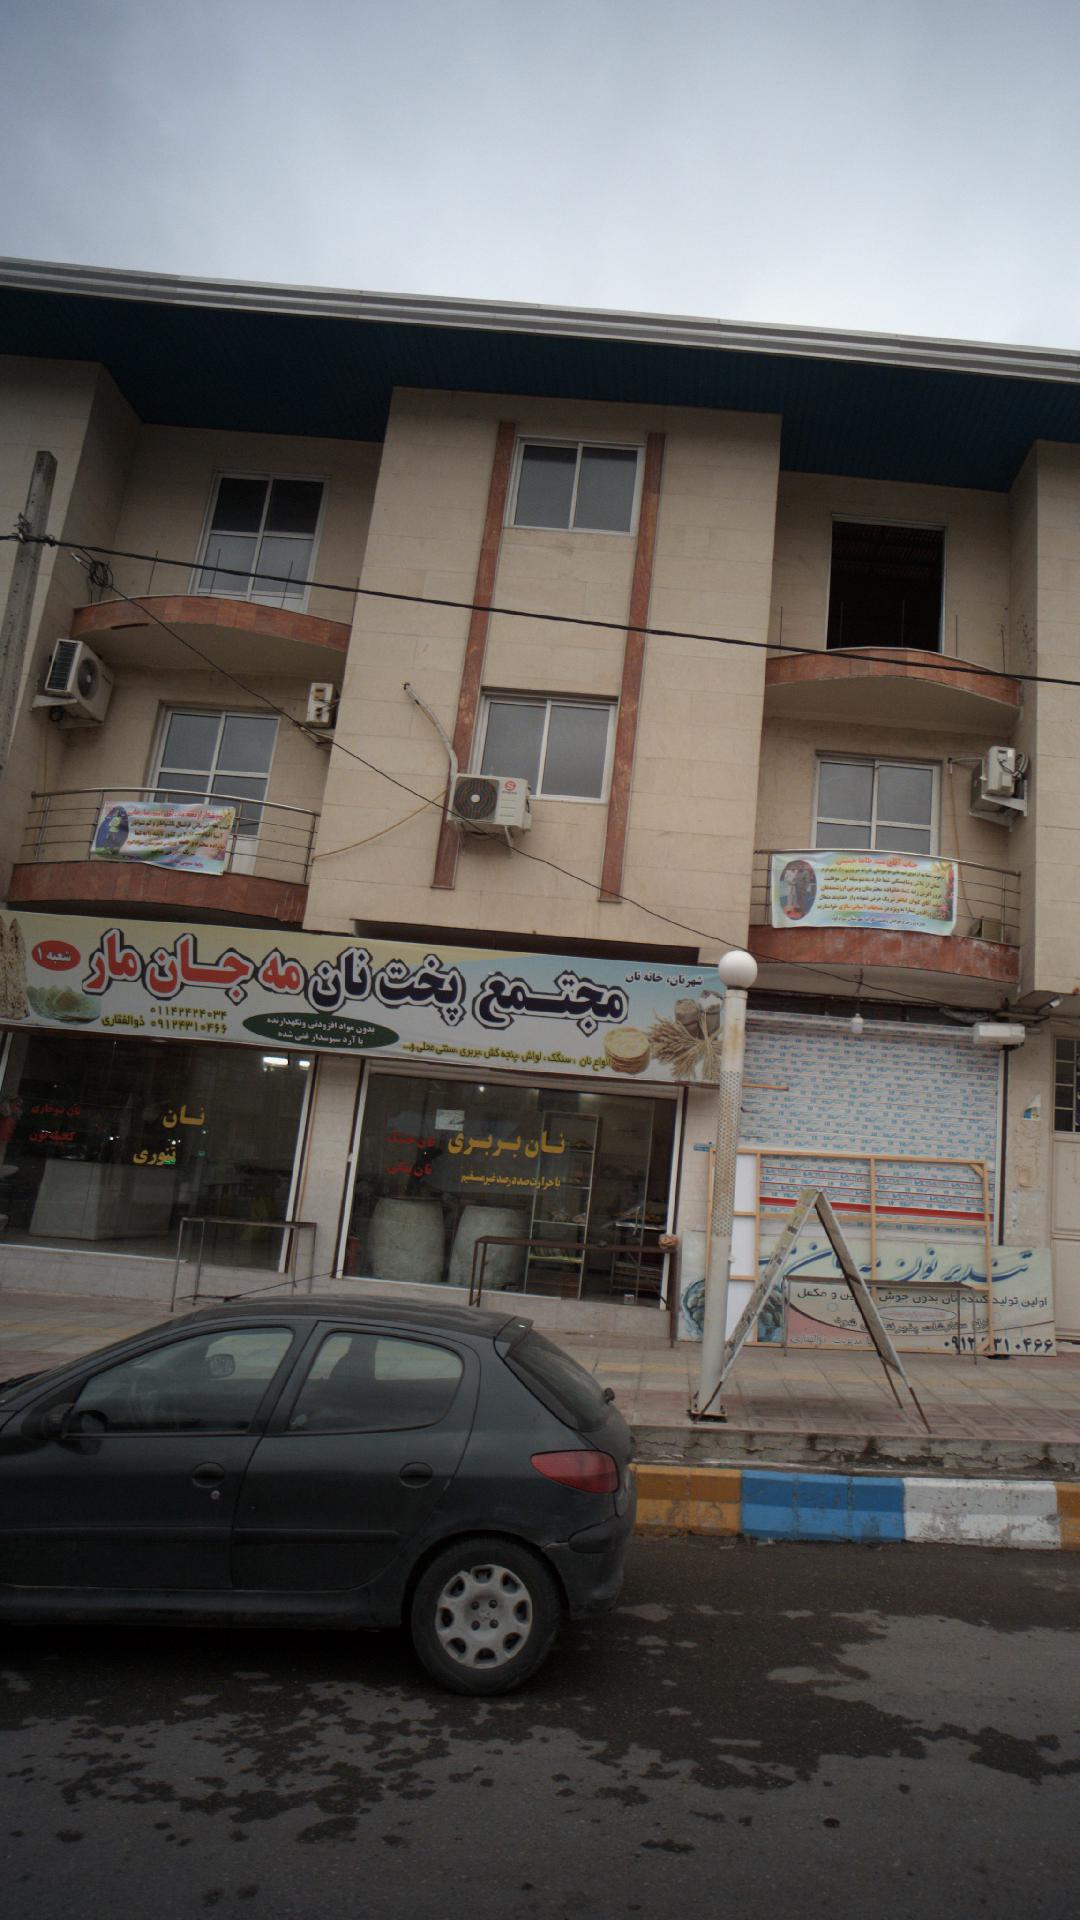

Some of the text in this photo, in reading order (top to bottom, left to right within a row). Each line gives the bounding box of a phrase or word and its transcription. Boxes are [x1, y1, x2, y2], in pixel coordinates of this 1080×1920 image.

[82, 928, 629, 1036] مجتمع پخت نان مه جان مار
[161, 1103, 206, 1128] نان
[448, 1130, 566, 1160] نان بربری
[912, 1293, 938, 1303] بدون
